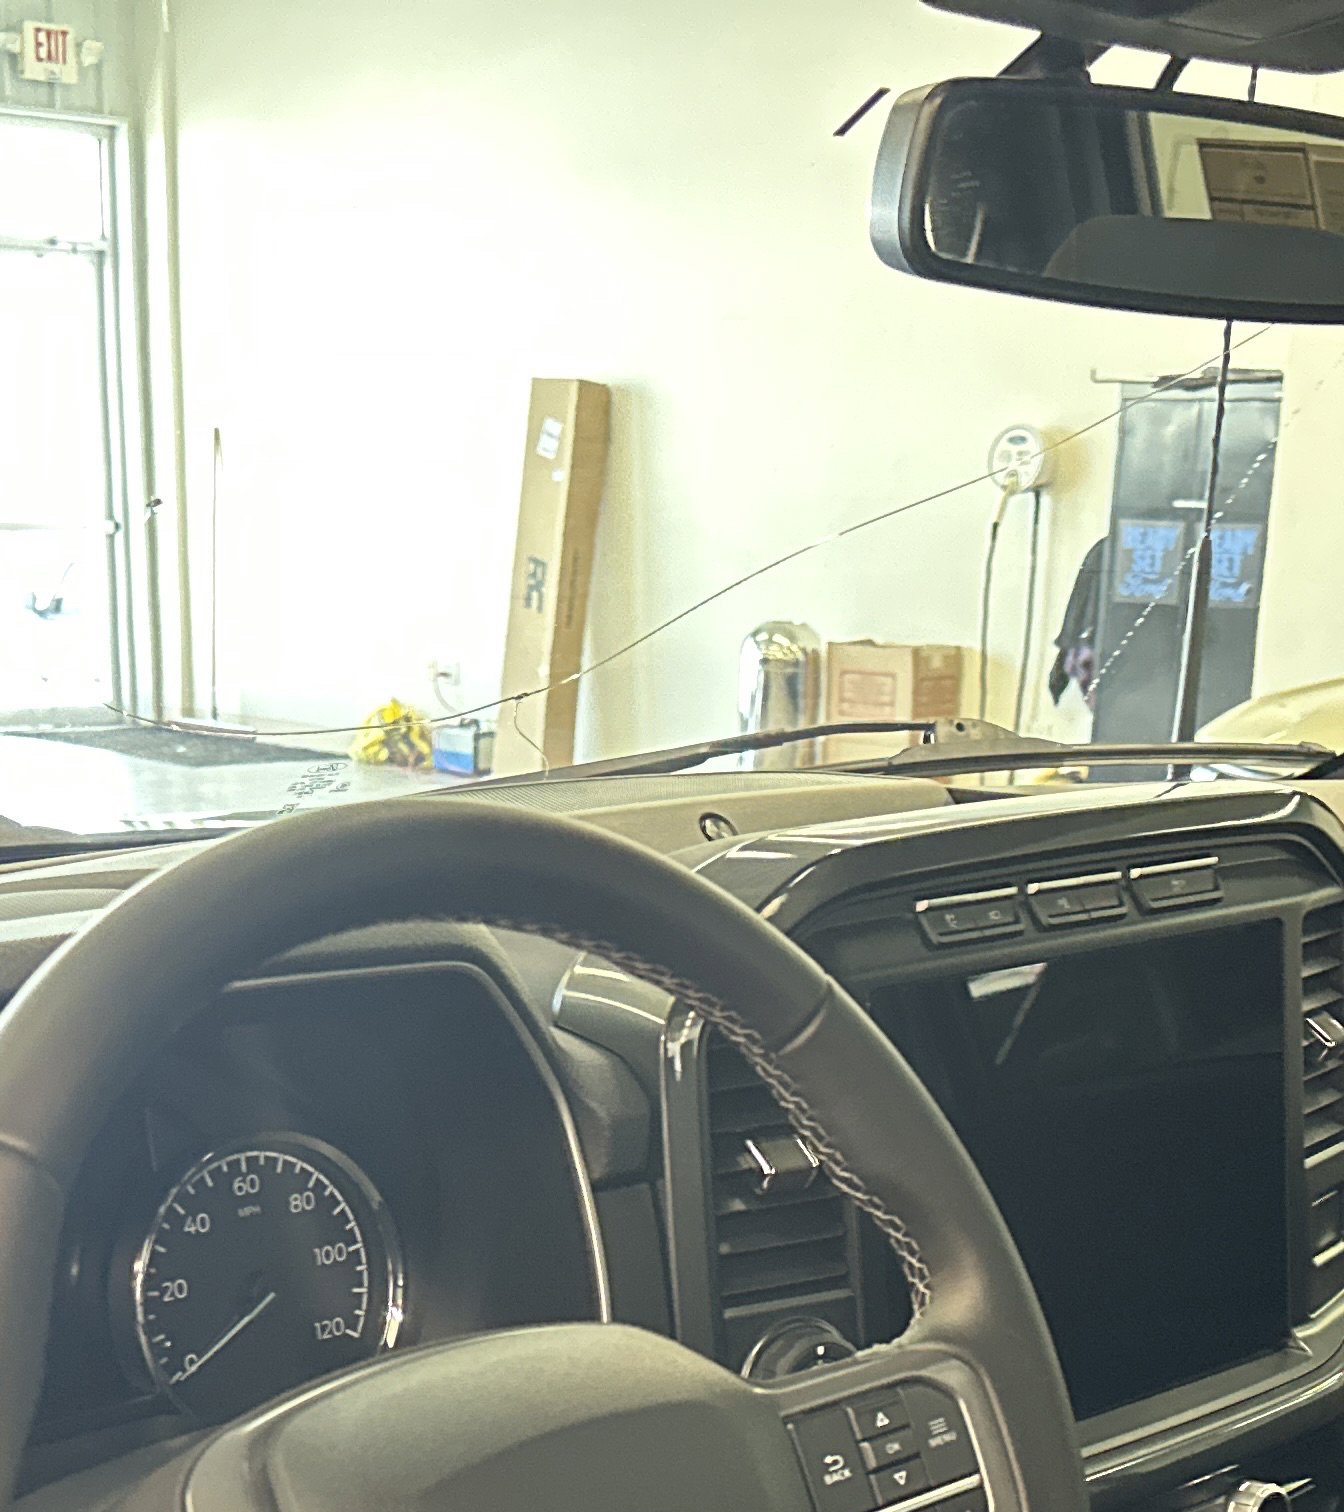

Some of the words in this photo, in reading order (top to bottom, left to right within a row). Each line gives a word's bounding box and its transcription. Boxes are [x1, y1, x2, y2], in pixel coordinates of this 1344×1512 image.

[33, 26, 70, 65] EXIT
[233, 1174, 259, 1195] 60
[288, 1191, 314, 1212] 80
[183, 1213, 210, 1234] 40
[313, 1242, 347, 1265] 100
[161, 1279, 188, 1301] 20
[314, 1317, 345, 1339] 120
[822, 1467, 852, 1486] BACK
